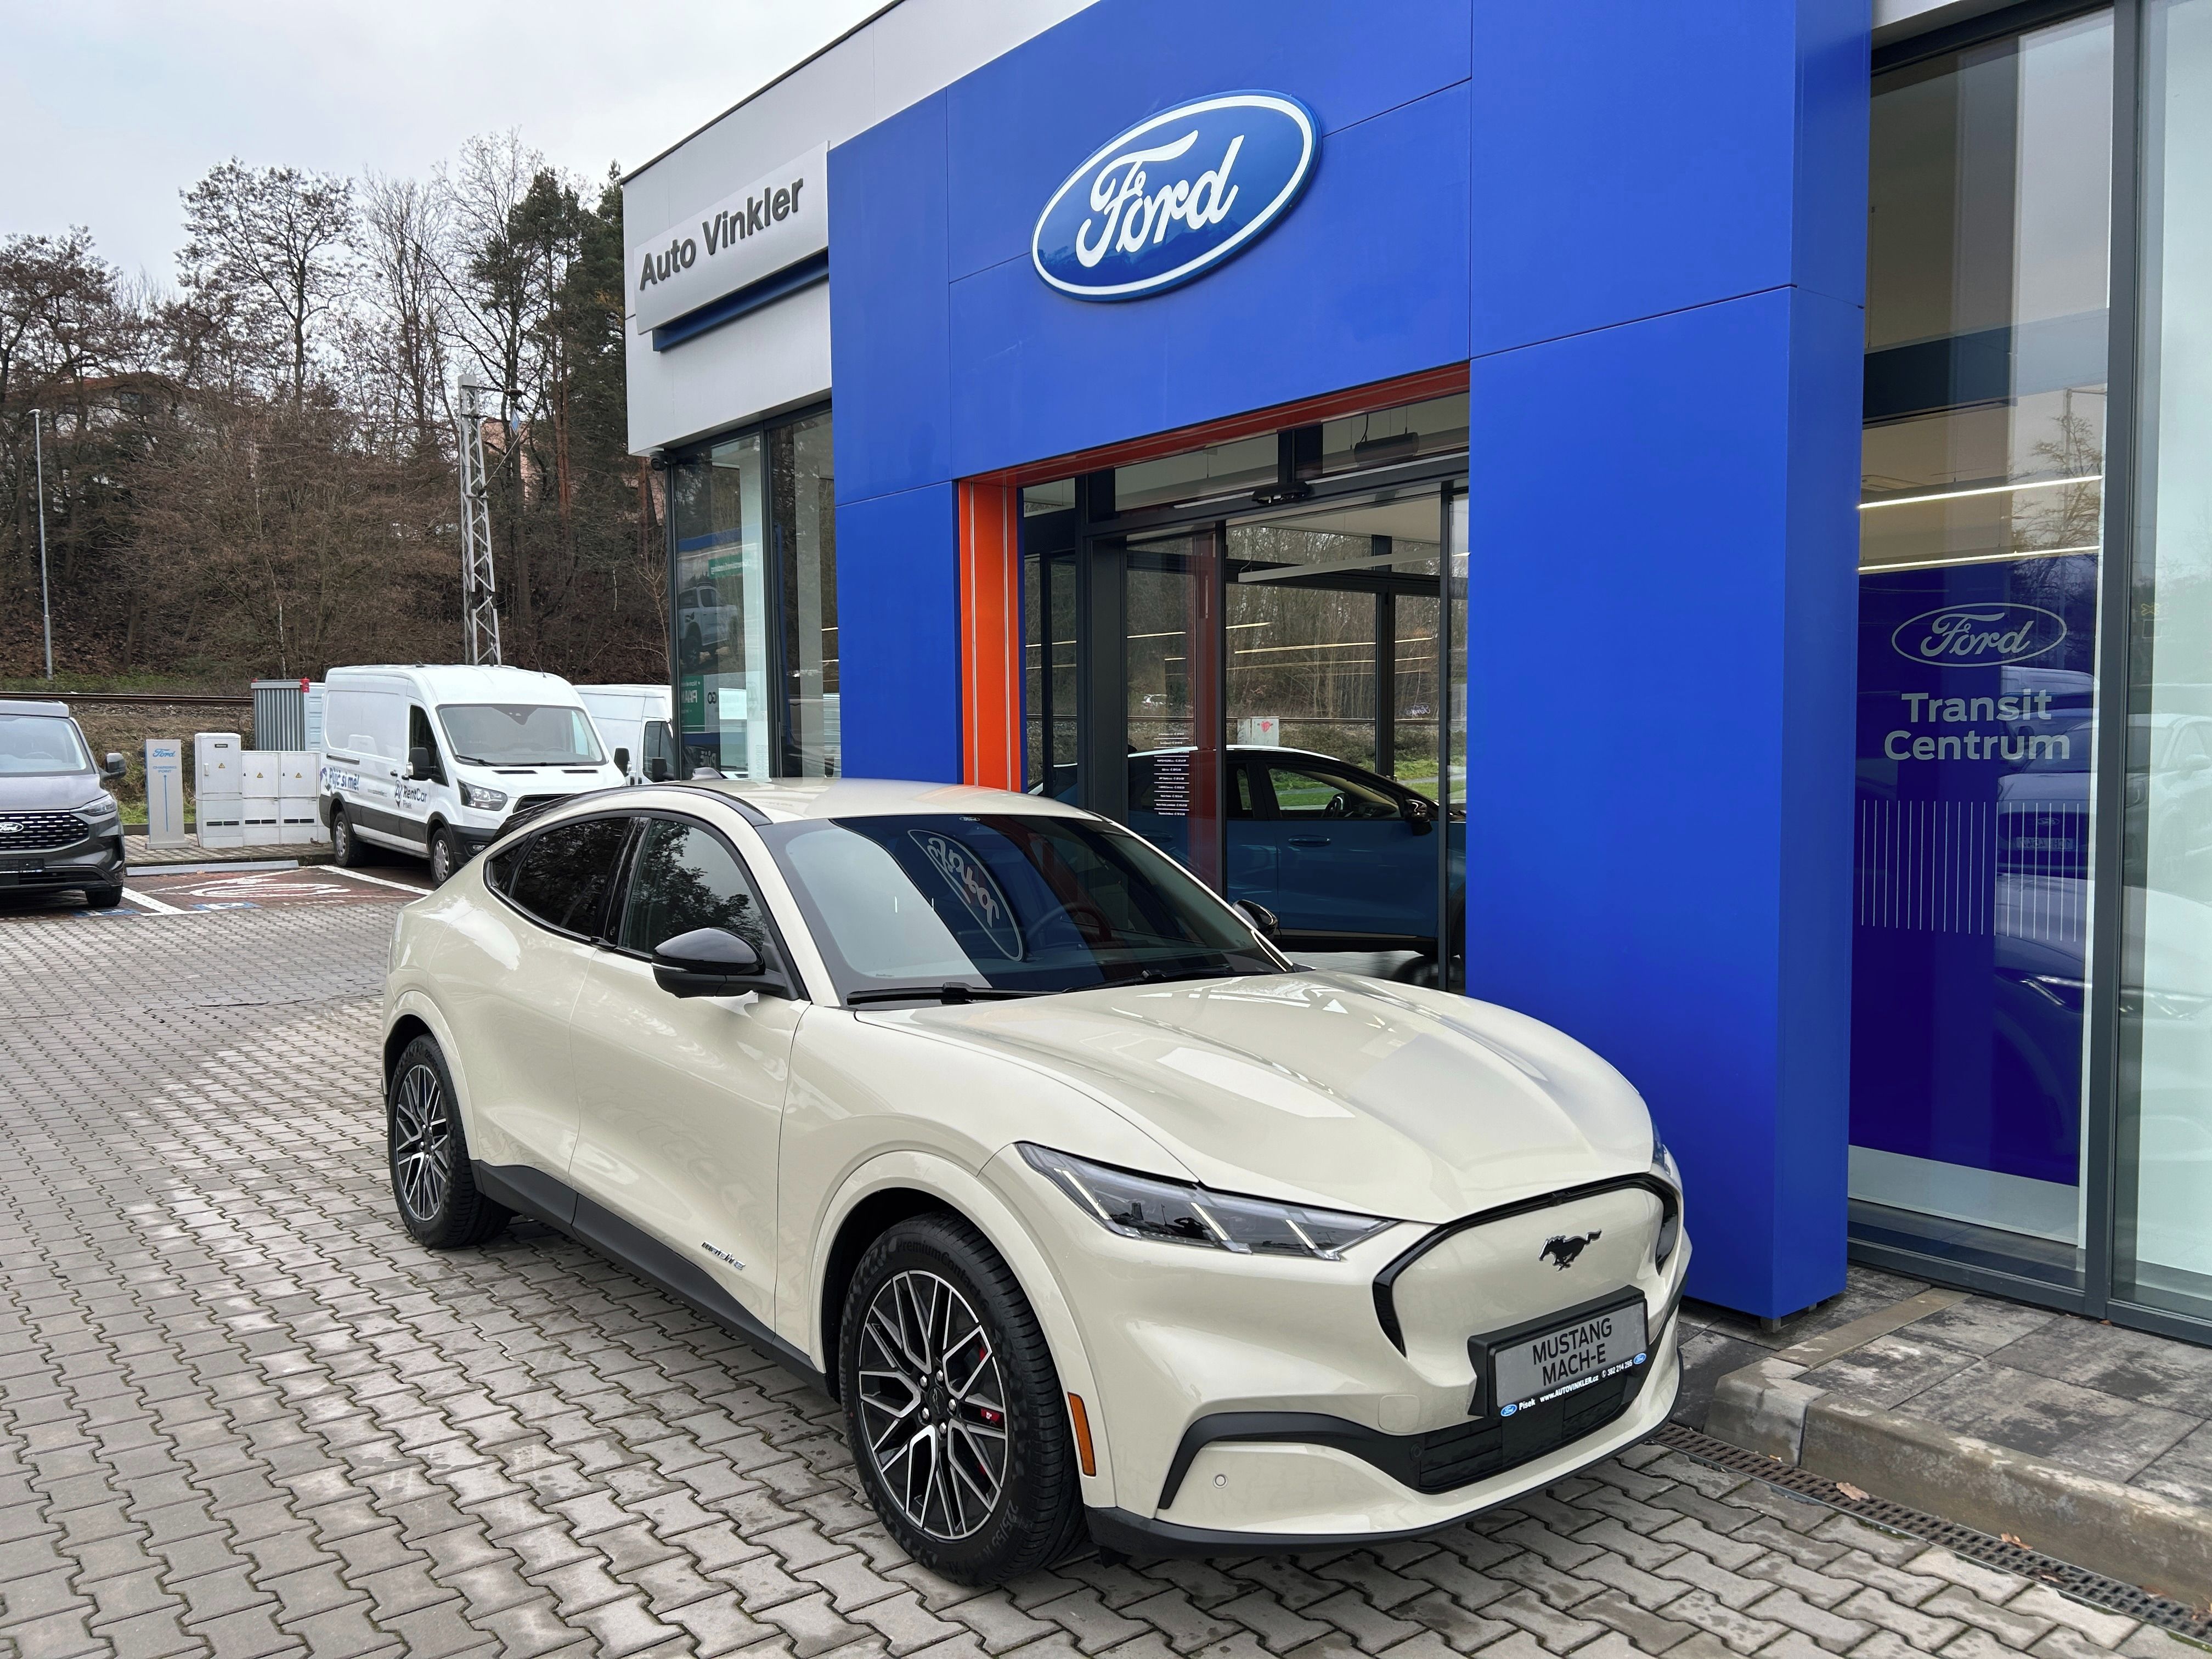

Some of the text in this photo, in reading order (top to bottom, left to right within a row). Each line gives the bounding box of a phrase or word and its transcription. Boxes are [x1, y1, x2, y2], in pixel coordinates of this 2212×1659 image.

[1075, 129, 1245, 268] Ford
[639, 177, 804, 291] Auto Vinkler
[1920, 612, 2035, 657] Ford
[1901, 689, 2052, 723] Transit
[153, 748, 176, 758] Ford
[1883, 730, 2070, 760] Centrum
[341, 771, 347, 788] si
[403, 785, 427, 803] RentCar
[896, 1239, 990, 1312] PremiumContact 6
[1532, 1317, 1612, 1365] MUSTANG
[1539, 1374, 1599, 1403] www.AUTOVINKLER.cz
[1616, 1363, 1624, 1373] 214
[1542, 1342, 1607, 1386] MACH-E
